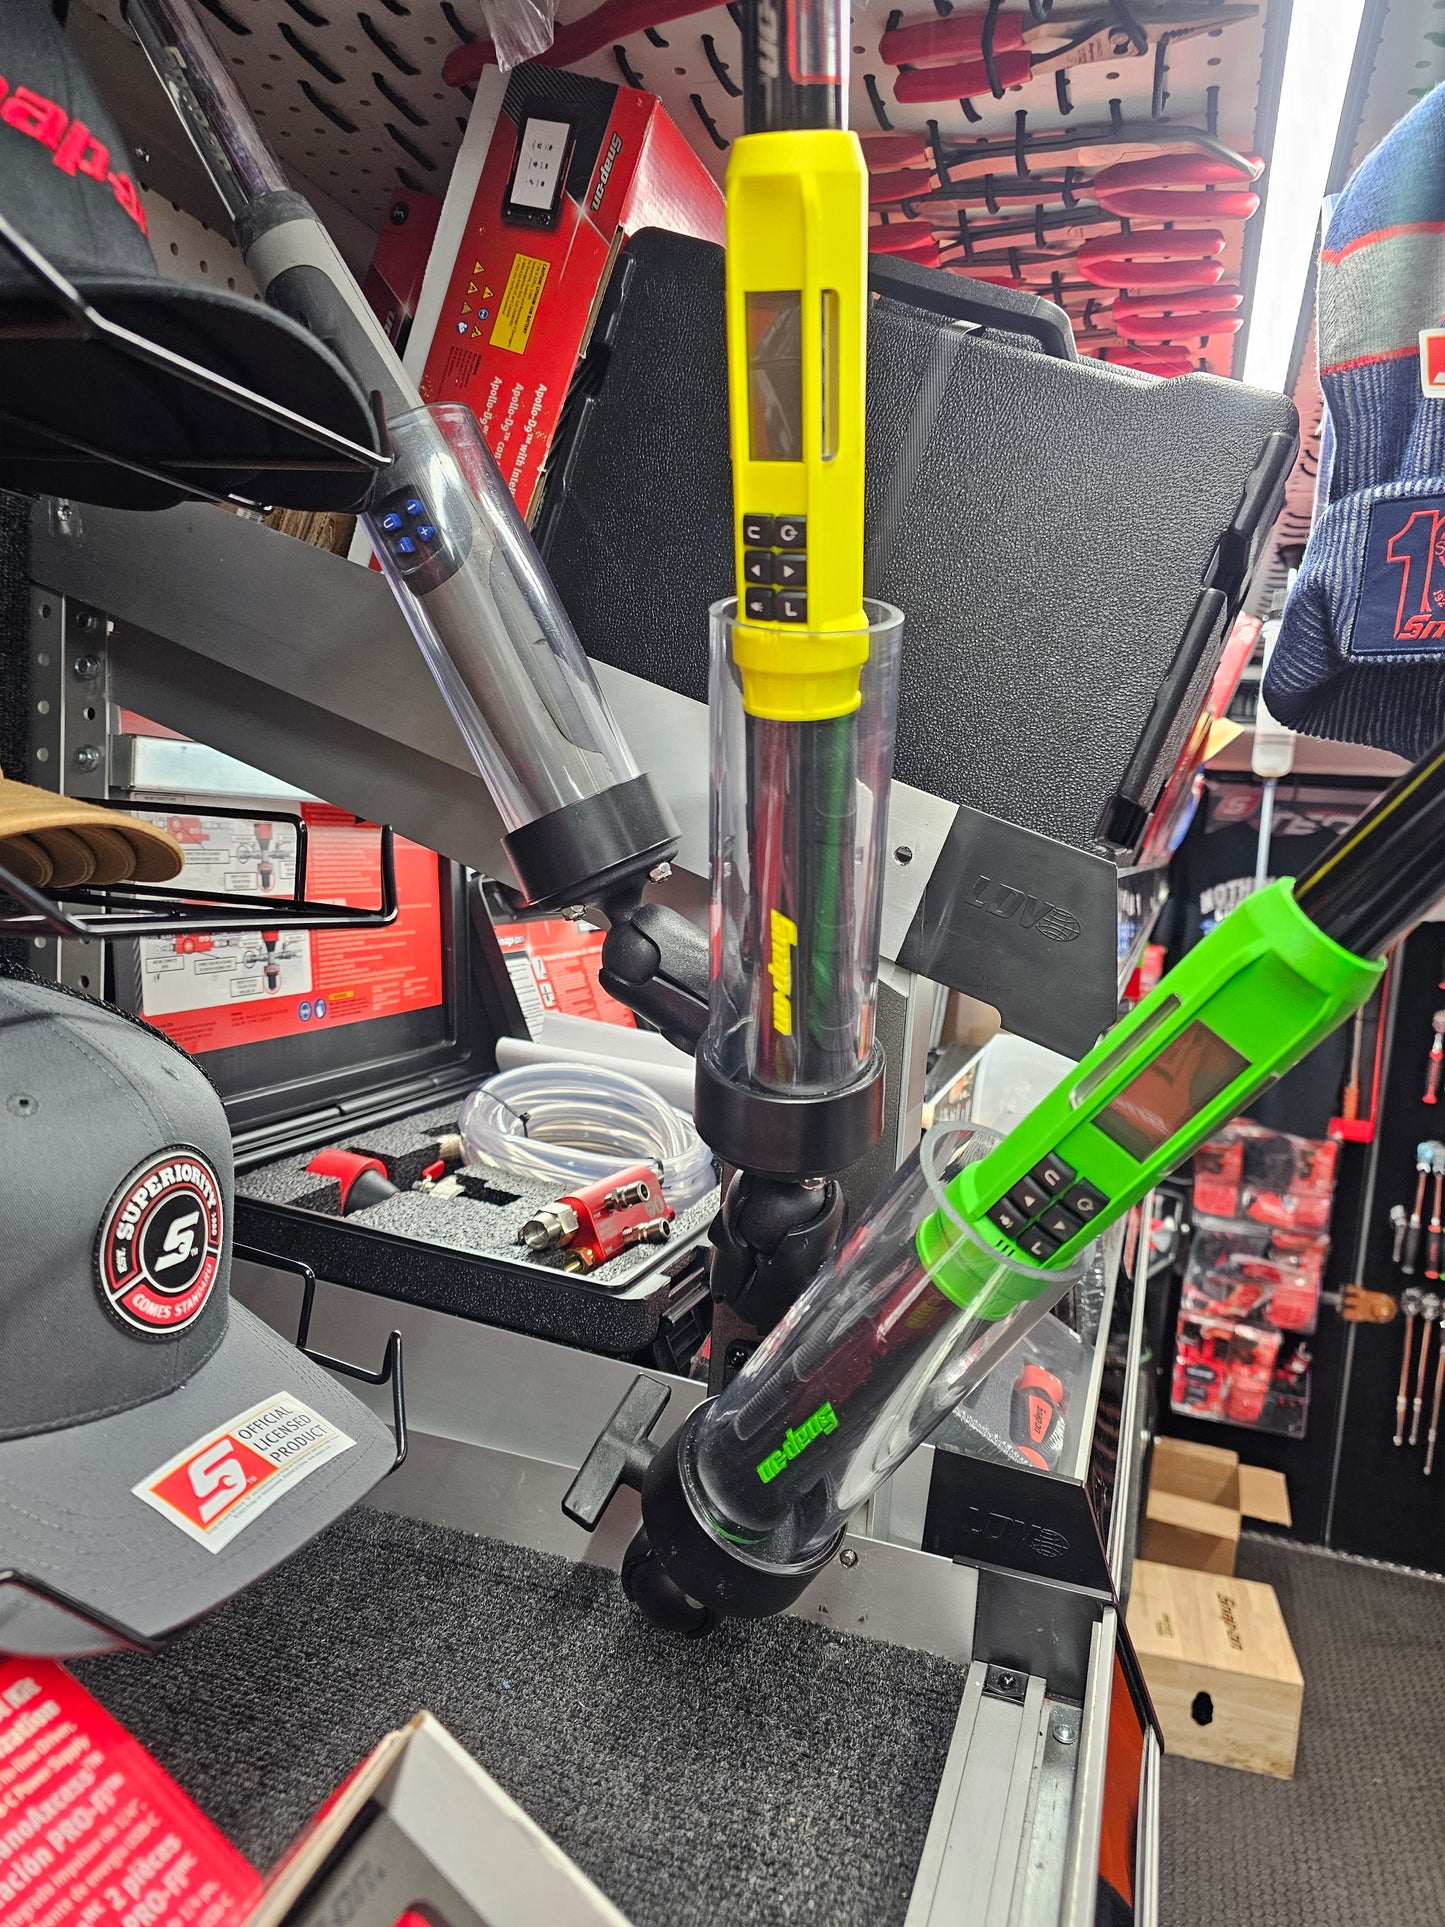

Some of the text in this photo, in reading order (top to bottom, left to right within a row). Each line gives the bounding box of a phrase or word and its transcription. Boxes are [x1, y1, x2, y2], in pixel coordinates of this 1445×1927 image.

[516, 443, 529, 465] with
[771, 909, 798, 1036] Snap-on
[116, 1163, 217, 1241] SUPERIORITY
[131, 1263, 213, 1319] COMES STANDARD
[238, 1404, 296, 1441] OFFICIAL
[252, 1412, 313, 1453] LICENSED
[1029, 1405, 1047, 1434] Snap-on
[269, 1423, 331, 1464] PRODUCT
[756, 1400, 842, 1484] Snap-on
[1216, 1590, 1243, 1651] Snap-on
[46, 1733, 91, 1773] Supply
[103, 1886, 128, 1912] 2
